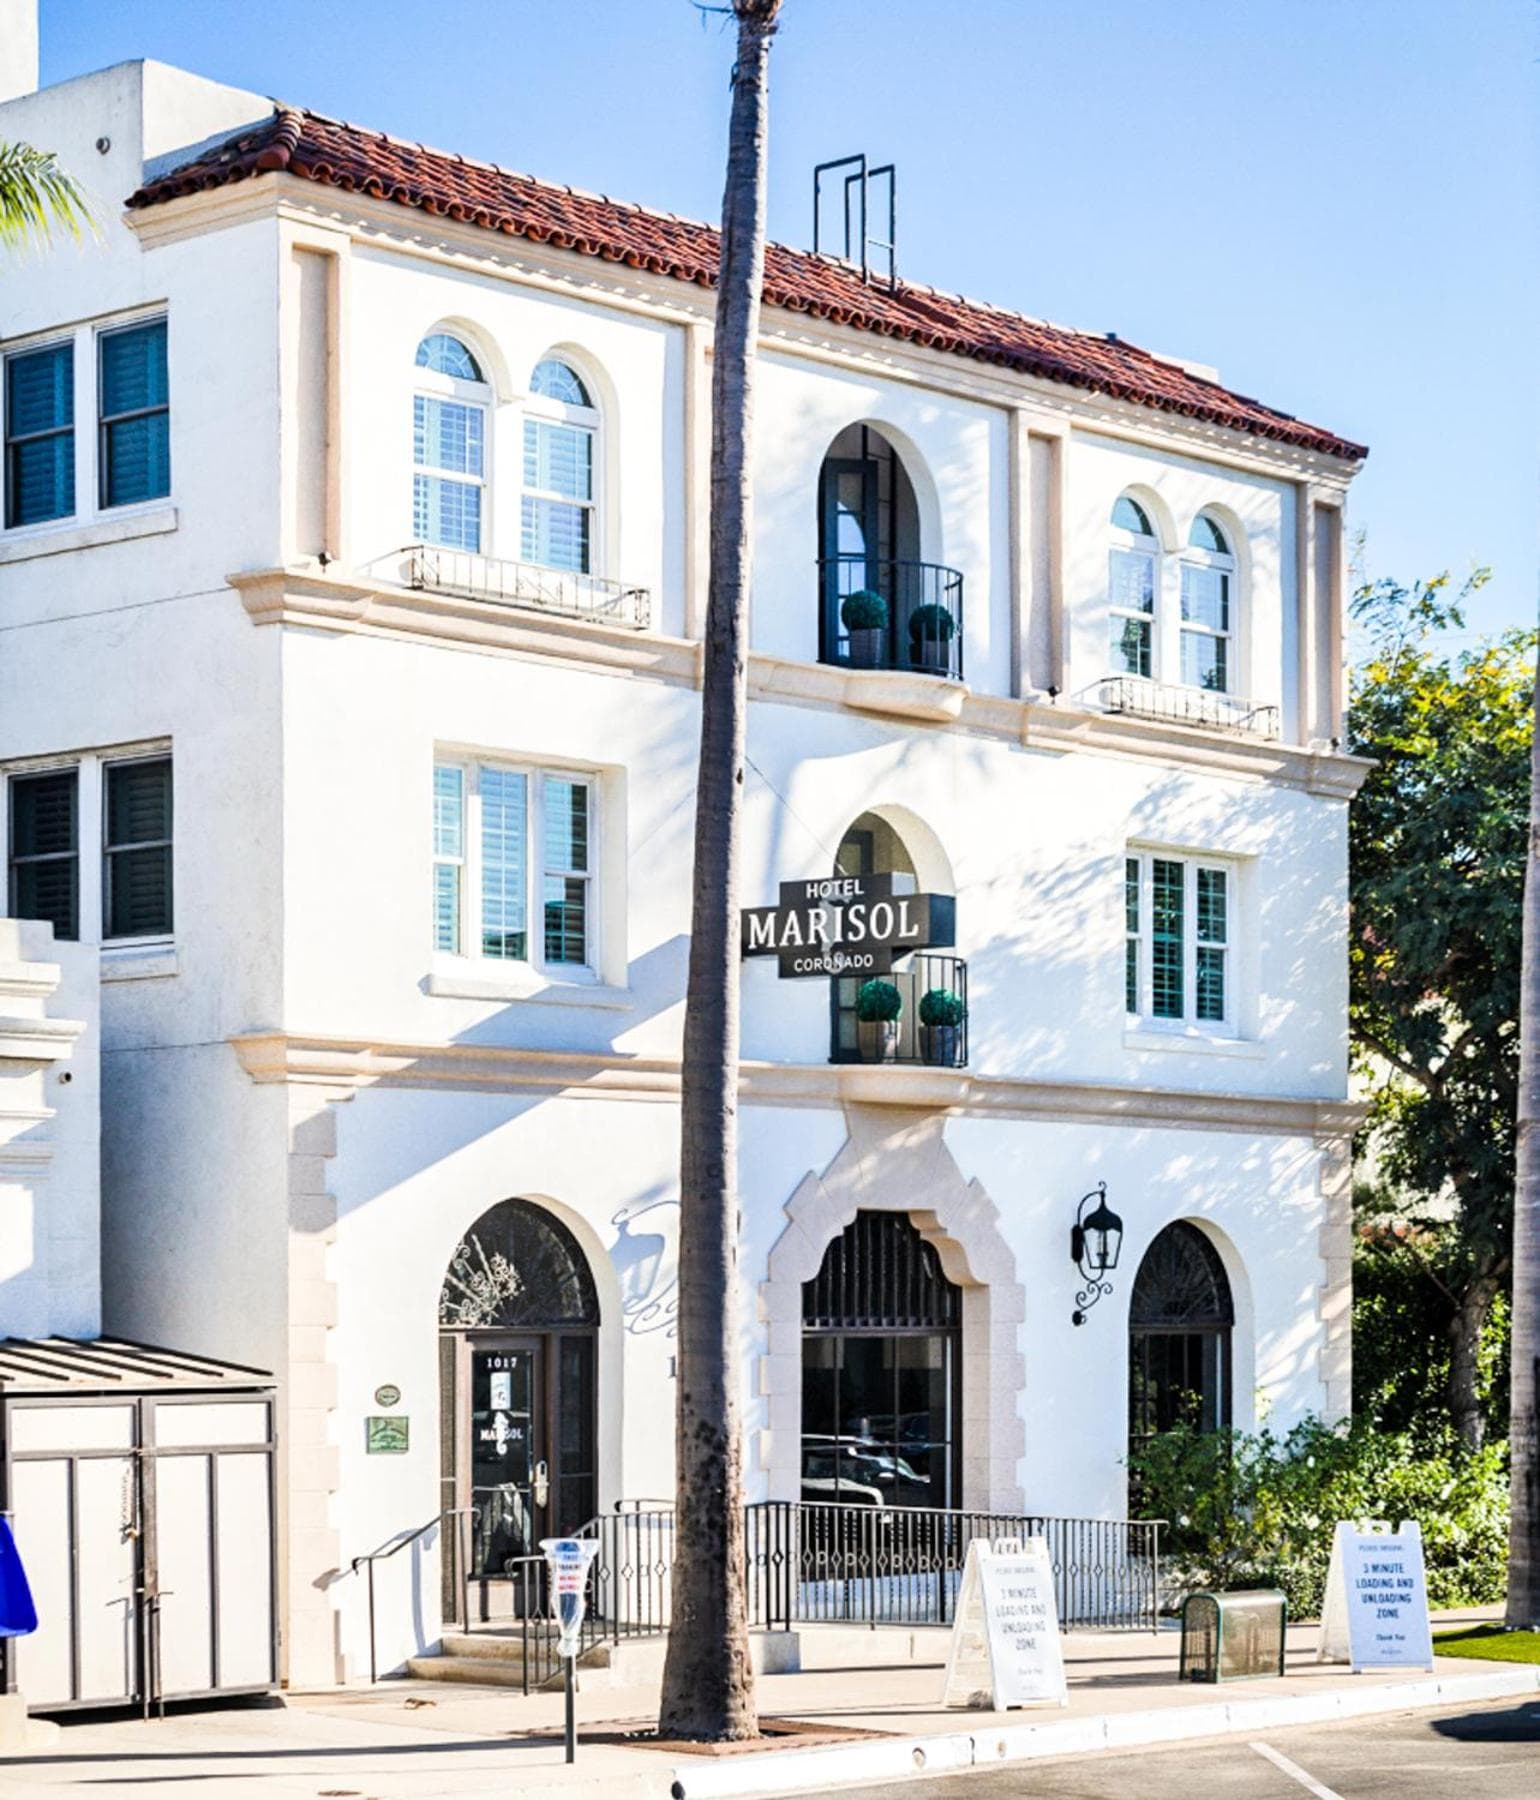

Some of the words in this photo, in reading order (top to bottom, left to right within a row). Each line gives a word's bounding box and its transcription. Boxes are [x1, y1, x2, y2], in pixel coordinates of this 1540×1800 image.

[806, 879, 865, 898] HOTEL
[748, 901, 919, 949] MARISOL
[794, 953, 874, 972] CORONADO
[487, 1357, 517, 1369] 1017
[480, 1427, 524, 1441] MASOL
[1371, 1562, 1404, 1574] MINUTE
[1356, 1577, 1394, 1589] LOADING
[1396, 1577, 1414, 1589] AND
[1361, 1593, 1412, 1604] UNLOADING
[1376, 1607, 1399, 1620] ZONE
